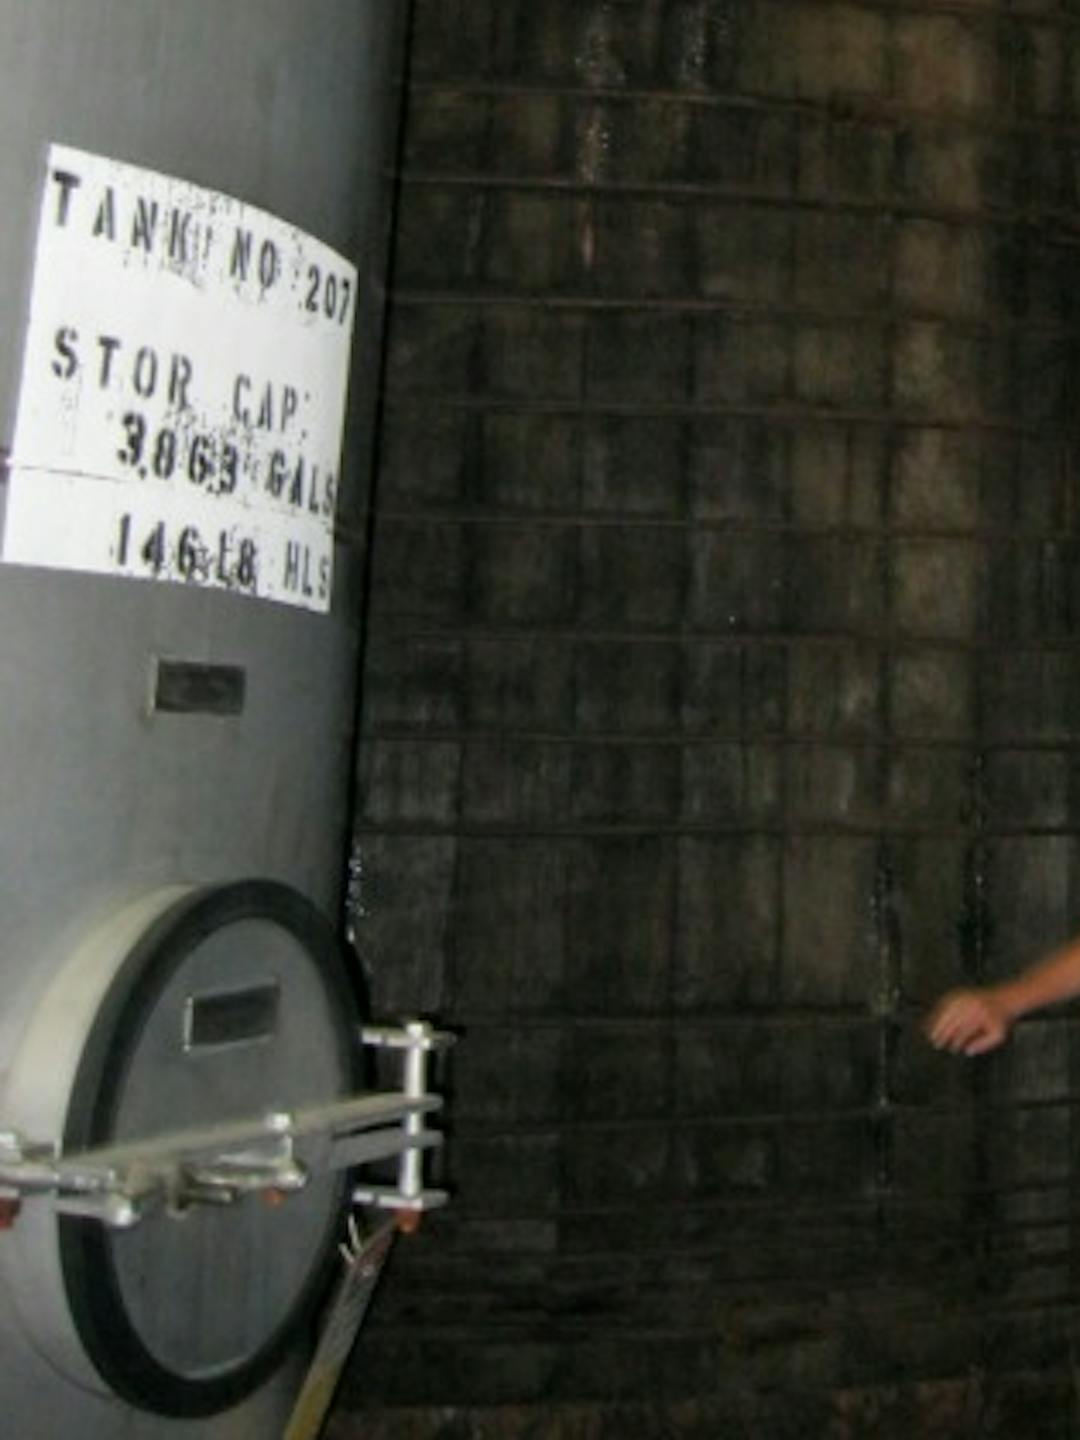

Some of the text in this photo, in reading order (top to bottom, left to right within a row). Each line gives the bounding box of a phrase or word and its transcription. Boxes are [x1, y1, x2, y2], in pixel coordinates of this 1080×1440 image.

[53, 170, 192, 261] TANK
[265, 449, 334, 517] GALS
[284, 539, 329, 600] HLS
